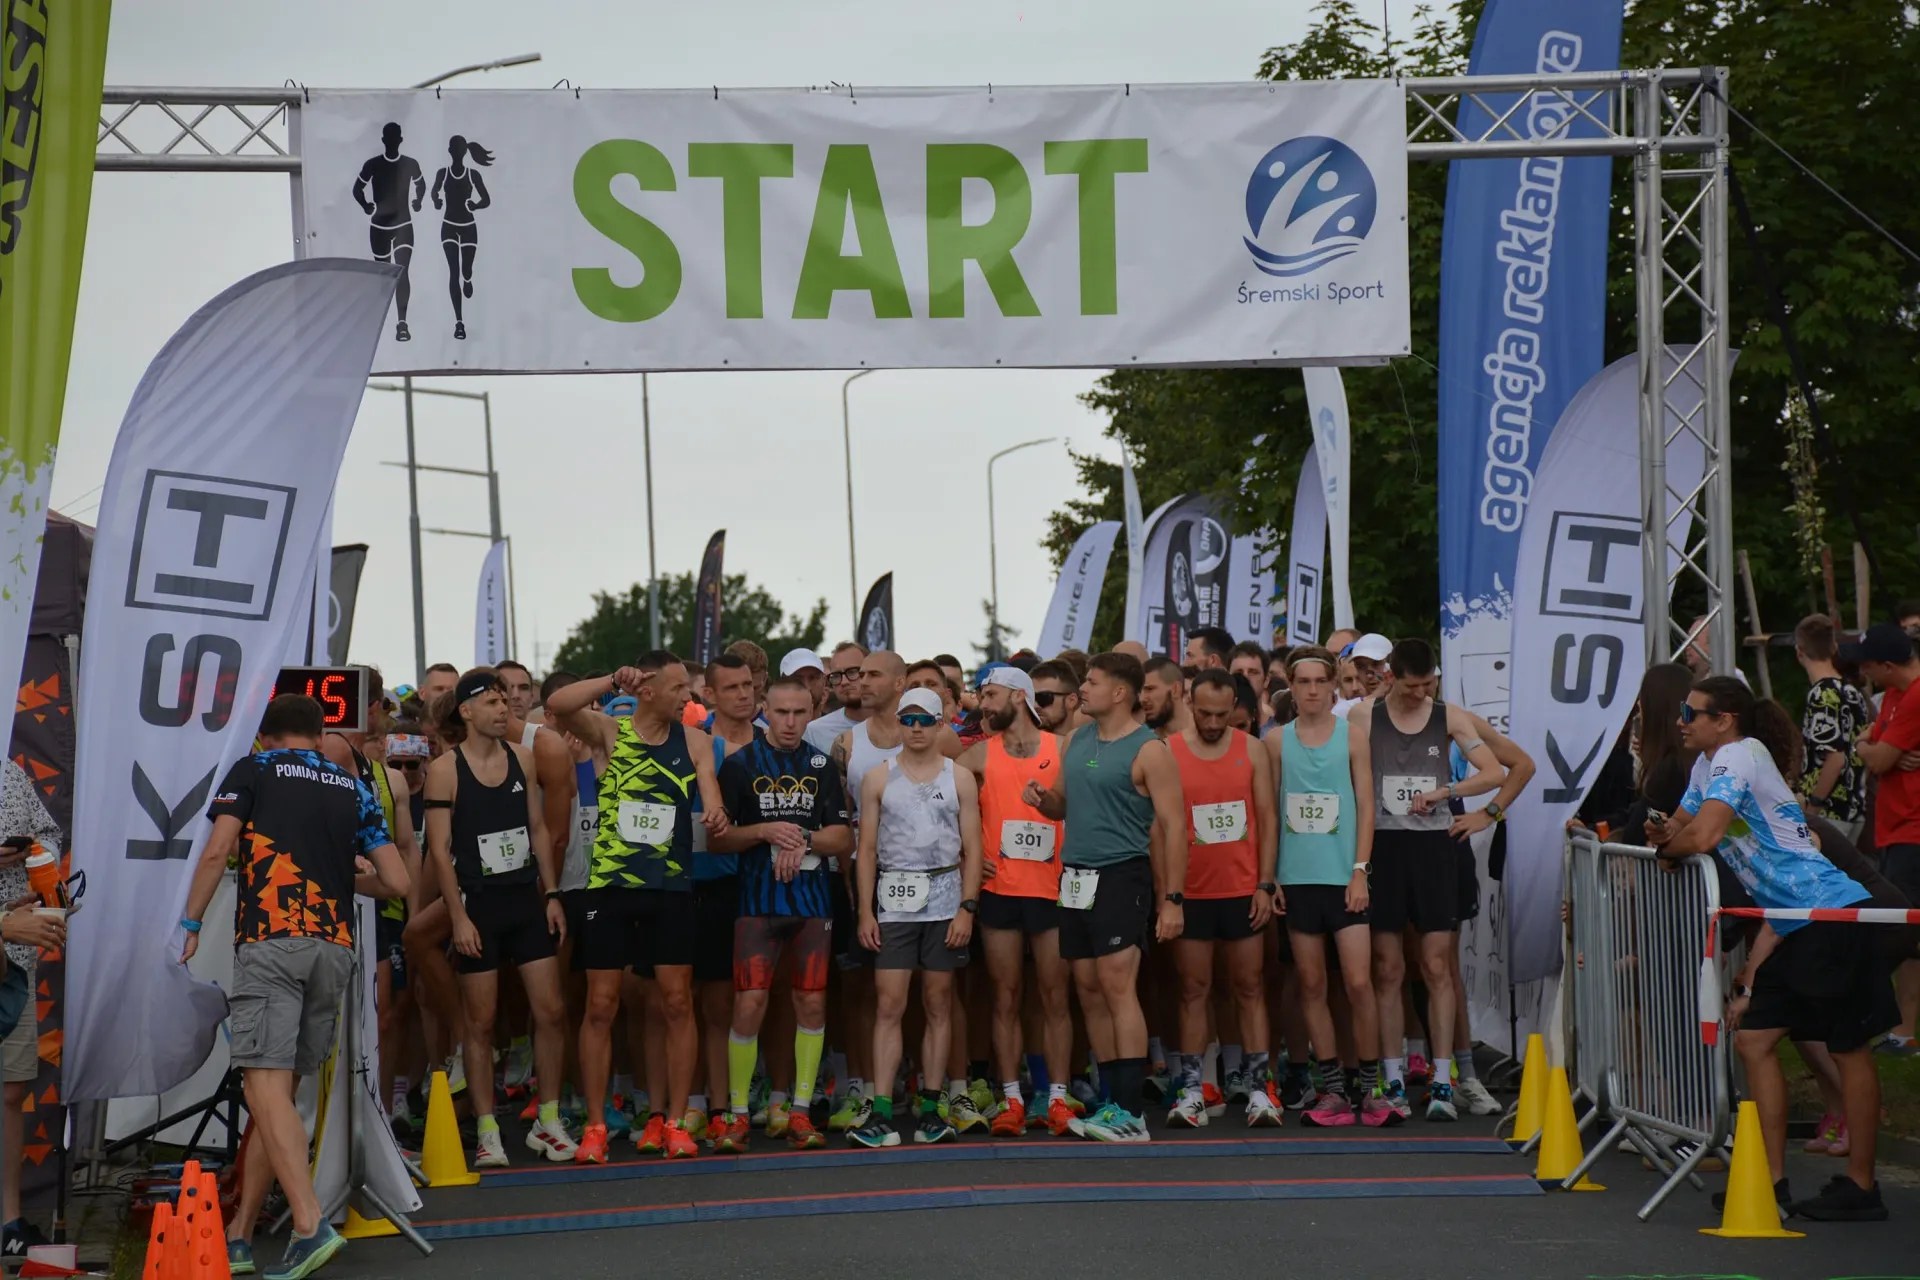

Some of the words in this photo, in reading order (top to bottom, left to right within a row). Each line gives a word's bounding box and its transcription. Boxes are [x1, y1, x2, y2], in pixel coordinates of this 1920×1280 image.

[571, 138, 1149, 322] START
[1237, 280, 1320, 304] Śremski
[1327, 280, 1385, 305] Sport
[1481, 327, 1545, 531] agencja
[276, 764, 319, 782] POMIAR
[321, 772, 355, 790] CZASU
[1299, 806, 1324, 819] 132
[632, 814, 660, 830] 182
[1207, 815, 1234, 829] 133
[1014, 833, 1042, 847] 301
[499, 843, 515, 857] 15
[888, 885, 916, 898] 395
[1070, 881, 1081, 894] 19
